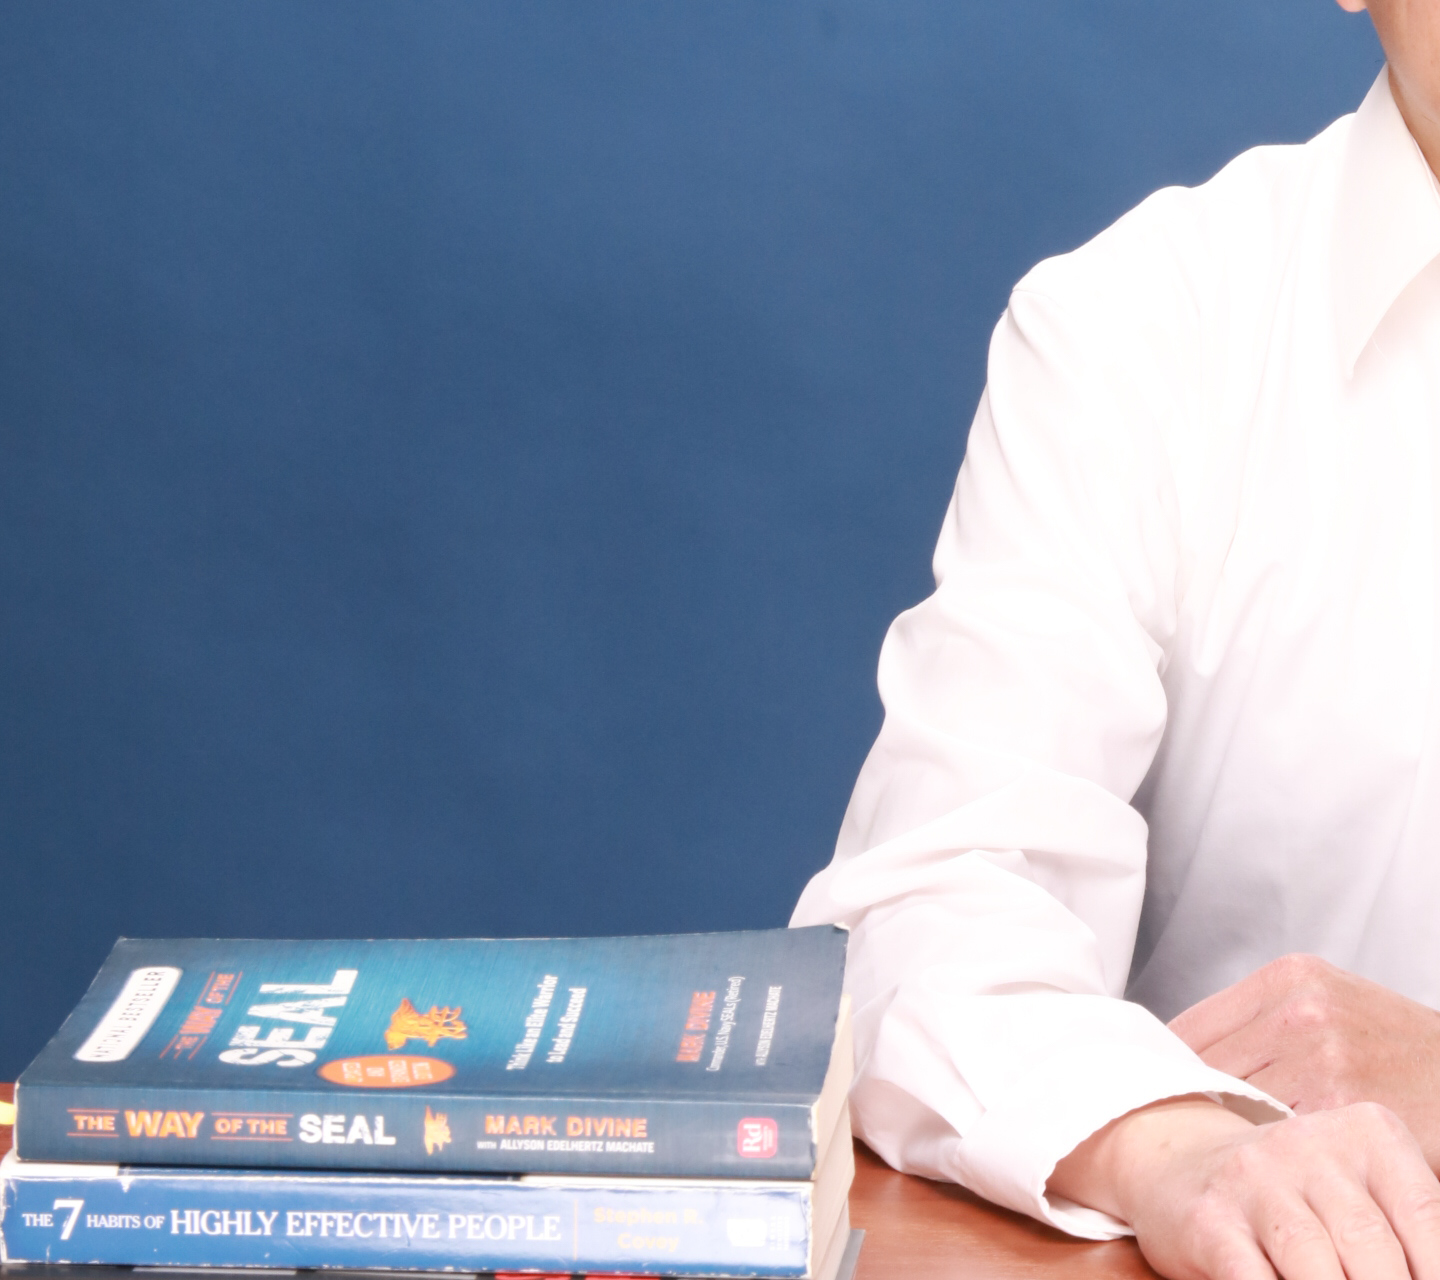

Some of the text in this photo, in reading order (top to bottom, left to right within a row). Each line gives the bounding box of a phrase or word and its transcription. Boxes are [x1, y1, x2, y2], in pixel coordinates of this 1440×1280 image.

[117, 970, 166, 1022] BESTSELLER
[531, 974, 559, 1008] Warrior
[724, 976, 747, 1002] (Retired)
[178, 1006, 223, 1035] WAY
[210, 973, 236, 990] THE
[560, 987, 587, 1023] Succeed
[686, 991, 716, 1030] DIVINE
[720, 1003, 737, 1020] SEALs
[218, 969, 358, 1067] SEAL
[525, 1008, 549, 1028] Elite
[717, 1020, 734, 1035] Navy
[552, 1023, 574, 1038] and
[514, 1038, 536, 1053] Like
[547, 1038, 569, 1055] Lead
[74, 1110, 397, 1145] THE WAY OF THE SEAL
[485, 1115, 648, 1138] MARK DIVINE
[742, 1123, 763, 1153] Rd
[476, 1138, 655, 1154] WITH ALLYSON EDELHERTZ MACHATE
[22, 1199, 562, 1242] THE 7 HABITS OF HIGHLY EFFECTIVE PEOPLE
[592, 1207, 678, 1227] Stephen
[617, 1232, 680, 1252] Covey
